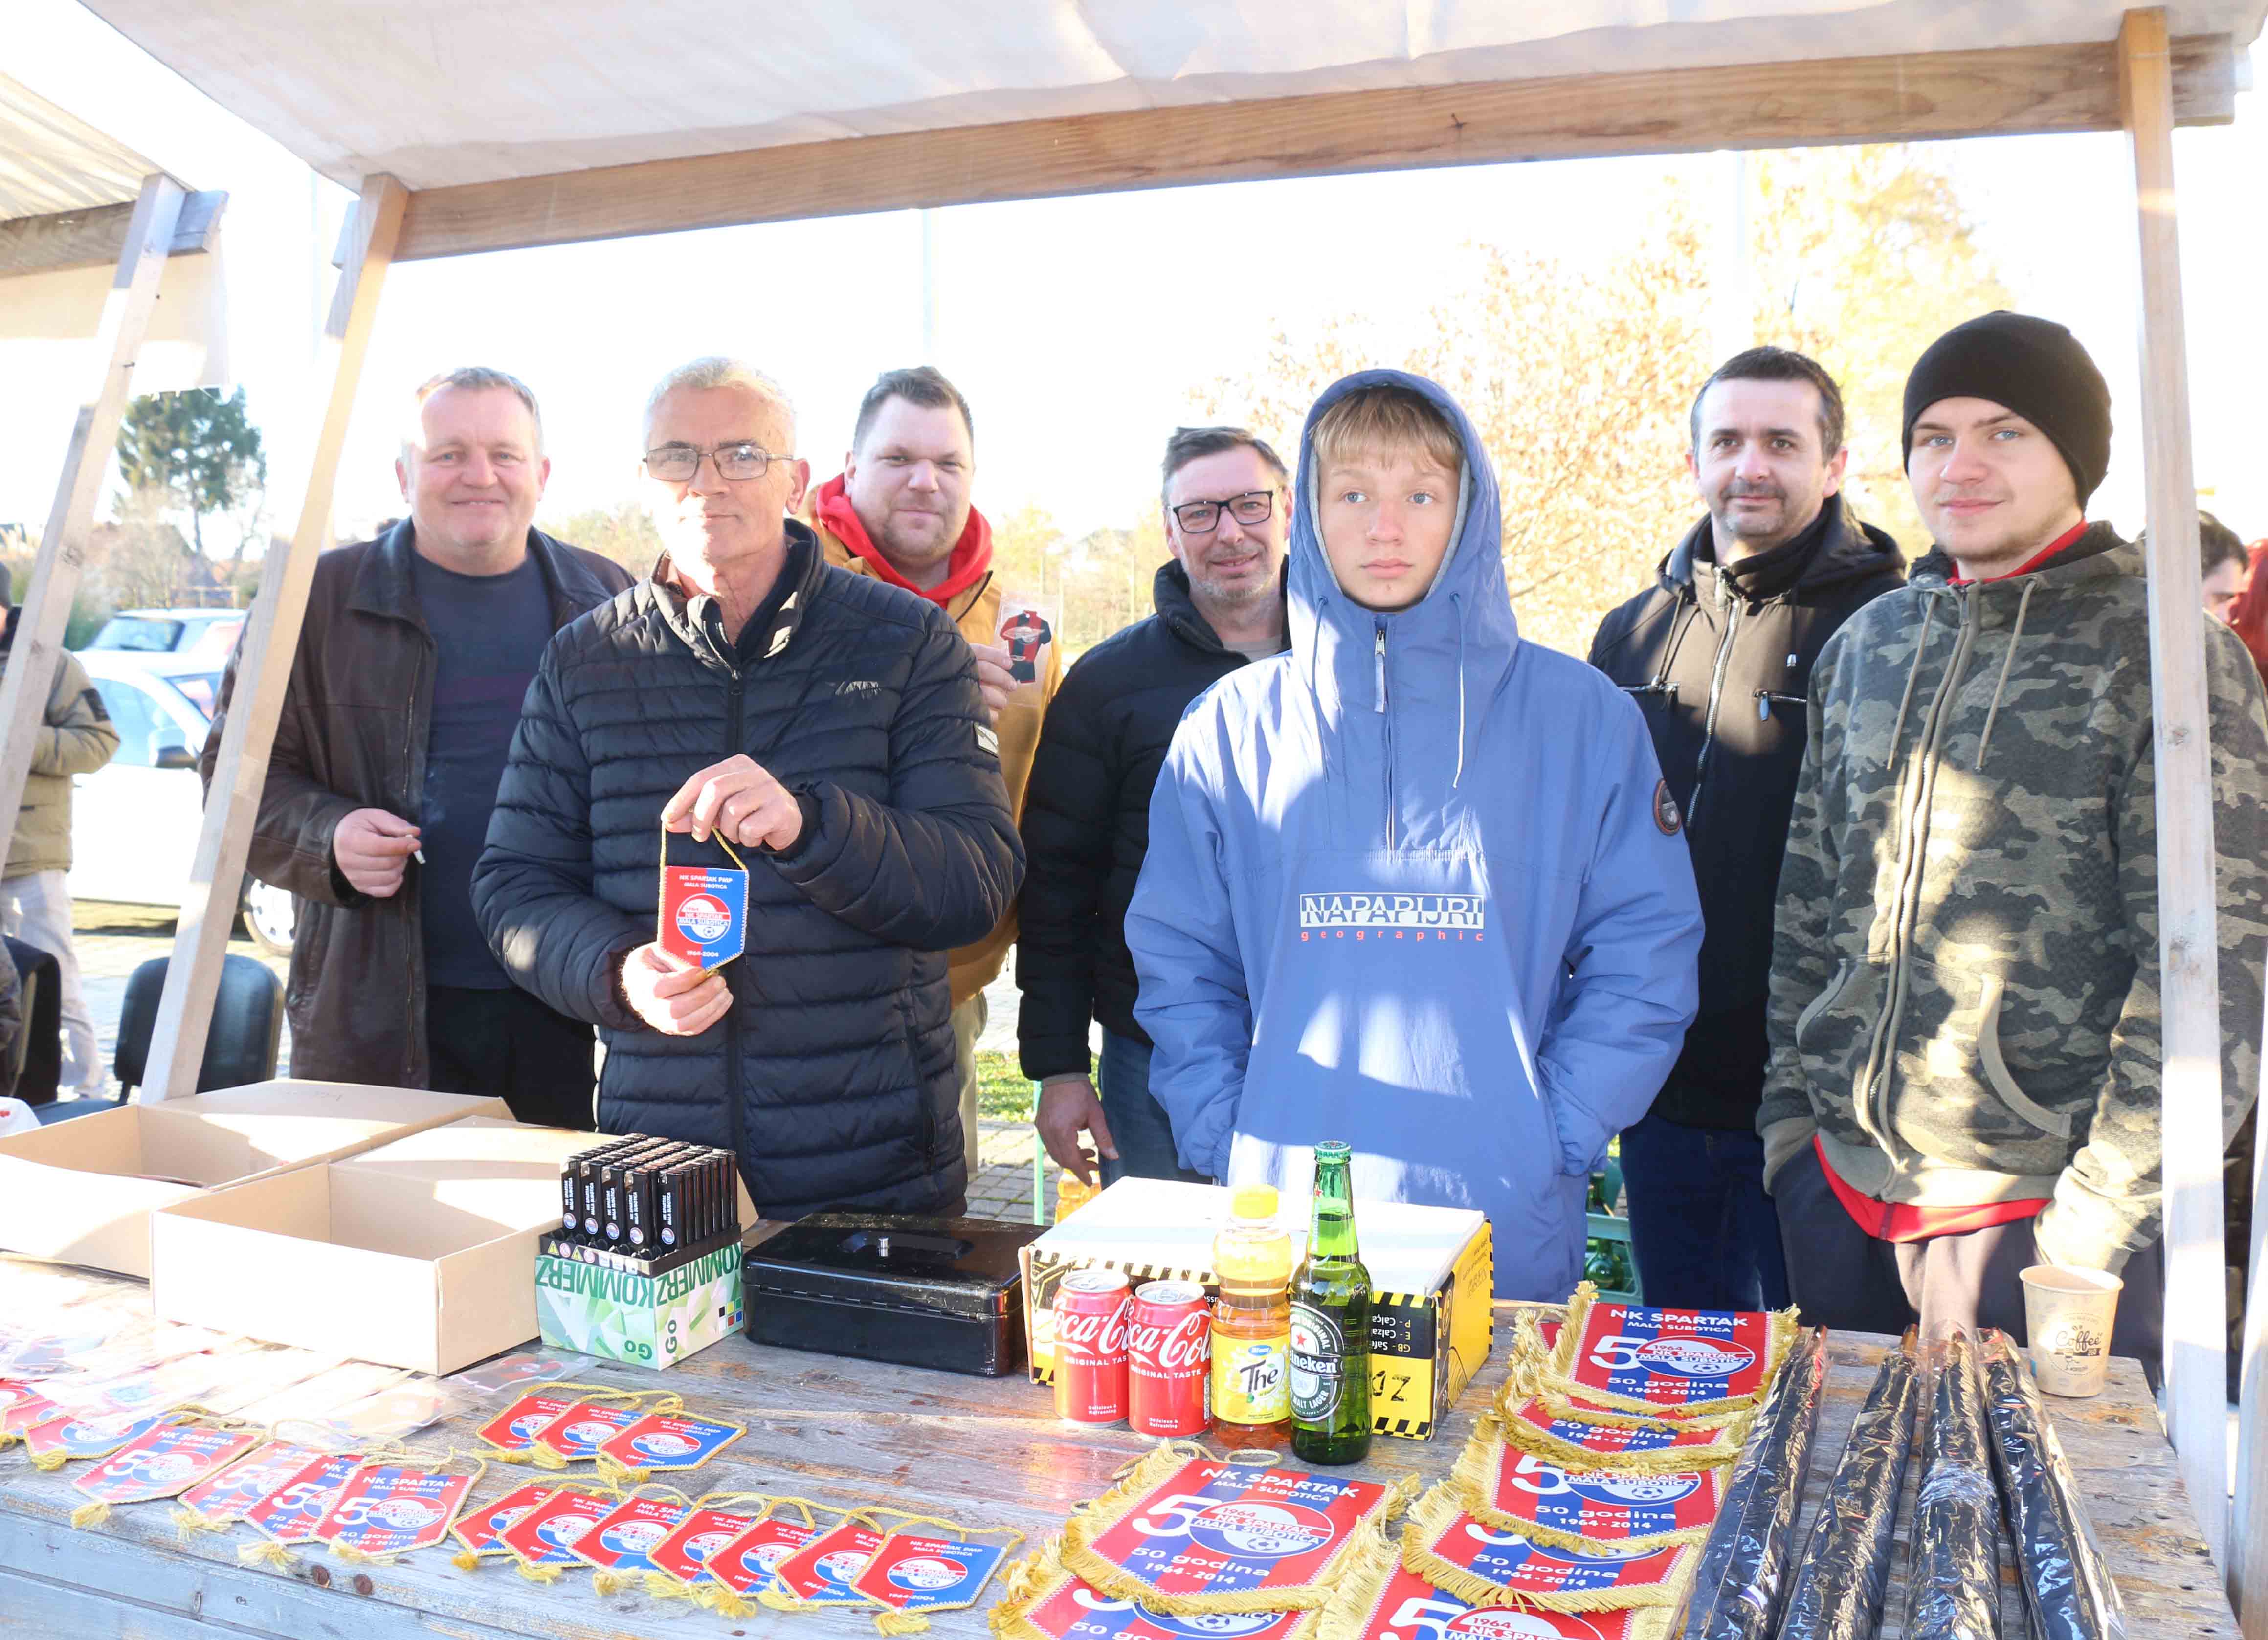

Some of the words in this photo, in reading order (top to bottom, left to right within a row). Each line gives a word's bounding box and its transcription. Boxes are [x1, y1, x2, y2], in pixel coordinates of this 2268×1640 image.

[1304, 896, 1483, 925] NAPAPIJRI
[1300, 930, 1484, 942] geographic
[657, 1242, 743, 1306] KOMMERZ
[535, 1256, 654, 1308] KOMMERZ
[1611, 1309, 1644, 1321] NK
[1650, 1312, 1748, 1327] SPARTAK
[1371, 1328, 1396, 1339] Calza
[1667, 1325, 1731, 1333] SUBOTICA
[1398, 1344, 1411, 1352] GB
[2056, 1330, 2101, 1354] Coffee
[1064, 1355, 1109, 1366] ORIGINAL
[1112, 1355, 1127, 1364] TAS
[1291, 1350, 1337, 1373] ineken
[1131, 1364, 1170, 1379] ORIGINAL
[1173, 1369, 1201, 1379] TASTE
[1240, 1360, 1278, 1392] The
[1644, 1379, 1729, 1389] godina
[1292, 1396, 1307, 1409] MALT
[1309, 1390, 1329, 1409] LAGER
[1551, 1420, 1583, 1429] 50
[1588, 1426, 1677, 1441] godina
[1568, 1432, 1601, 1441] 1964
[1611, 1437, 1648, 1447] 2014
[362, 1476, 386, 1485] NK
[389, 1477, 455, 1487] SPARTAK
[1201, 1468, 1242, 1484] NK
[1245, 1473, 1360, 1499] SPARTAK
[1567, 1476, 1612, 1485] MALA
[1213, 1480, 1253, 1490] MALA
[1256, 1485, 1330, 1502] SUBOTICA
[1221, 1507, 1256, 1518] 1964
[1535, 1505, 1569, 1514] 50
[1578, 1509, 1677, 1520] godina
[1215, 1514, 1244, 1527] NK
[1245, 1518, 1312, 1535] SPARTAK
[1560, 1518, 1599, 1526] 1964
[361, 1532, 416, 1540] godina
[1194, 1518, 1241, 1533] MALA
[1243, 1526, 1320, 1545] SUBOTICA
[924, 1542, 962, 1551] SPARTAK
[935, 1548, 973, 1557] SUBOTICA
[1131, 1547, 1166, 1559] 50
[1171, 1553, 1270, 1577] godina
[1473, 1554, 1509, 1566] 50
[1515, 1563, 1619, 1579] godina
[1145, 1562, 1184, 1576] 1964
[1193, 1571, 1237, 1586] 2014
[1491, 1568, 1528, 1580] 1964
[1543, 1575, 1587, 1587] 2014
[1070, 1621, 1107, 1635] 50
[1473, 1617, 1512, 1629] 1964
[1448, 1631, 1496, 1640] MAL
[1468, 1626, 1497, 1637] NK
[1502, 1630, 1553, 1640] SPAR
